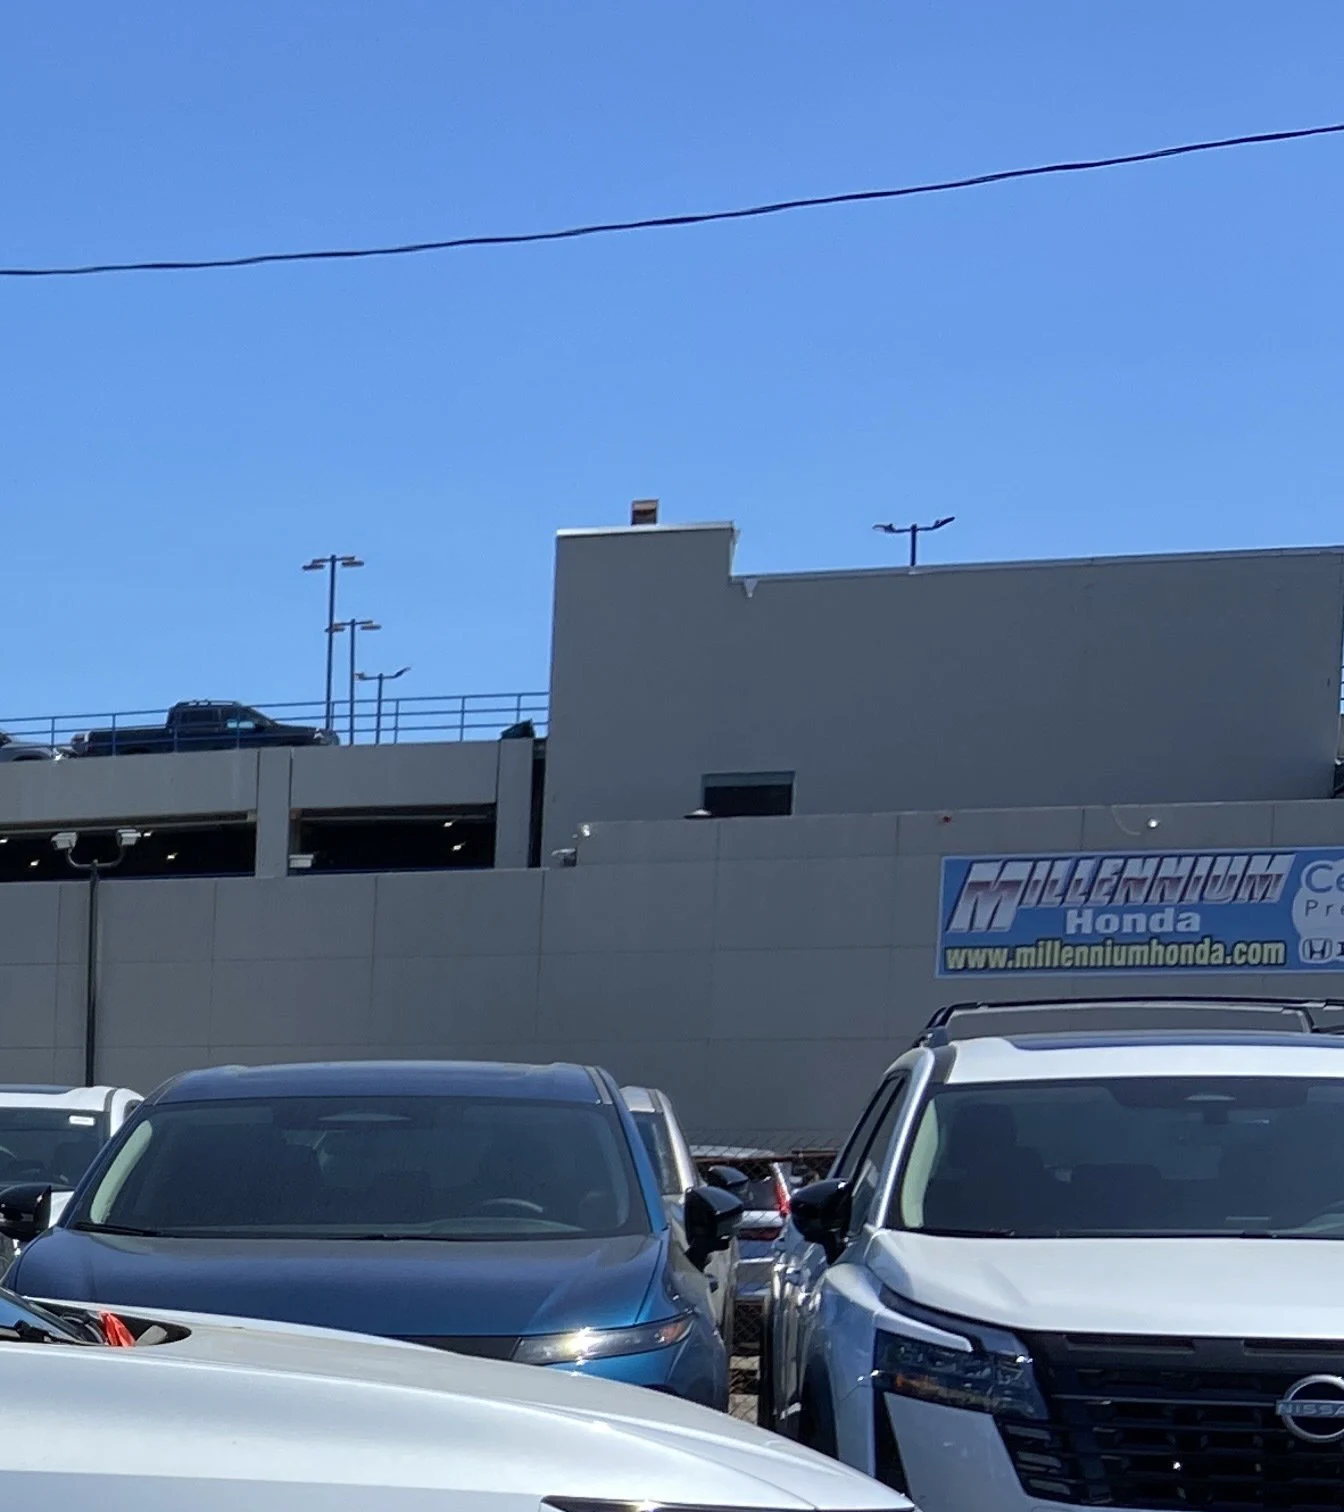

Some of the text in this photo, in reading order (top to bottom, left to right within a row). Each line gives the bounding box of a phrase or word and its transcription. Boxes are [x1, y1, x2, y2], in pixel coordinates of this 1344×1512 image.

[946, 853, 1297, 933] MILLENNIUM
[1065, 907, 1202, 936] Honda
[945, 936, 1286, 971] www.millenniumhonda.com
